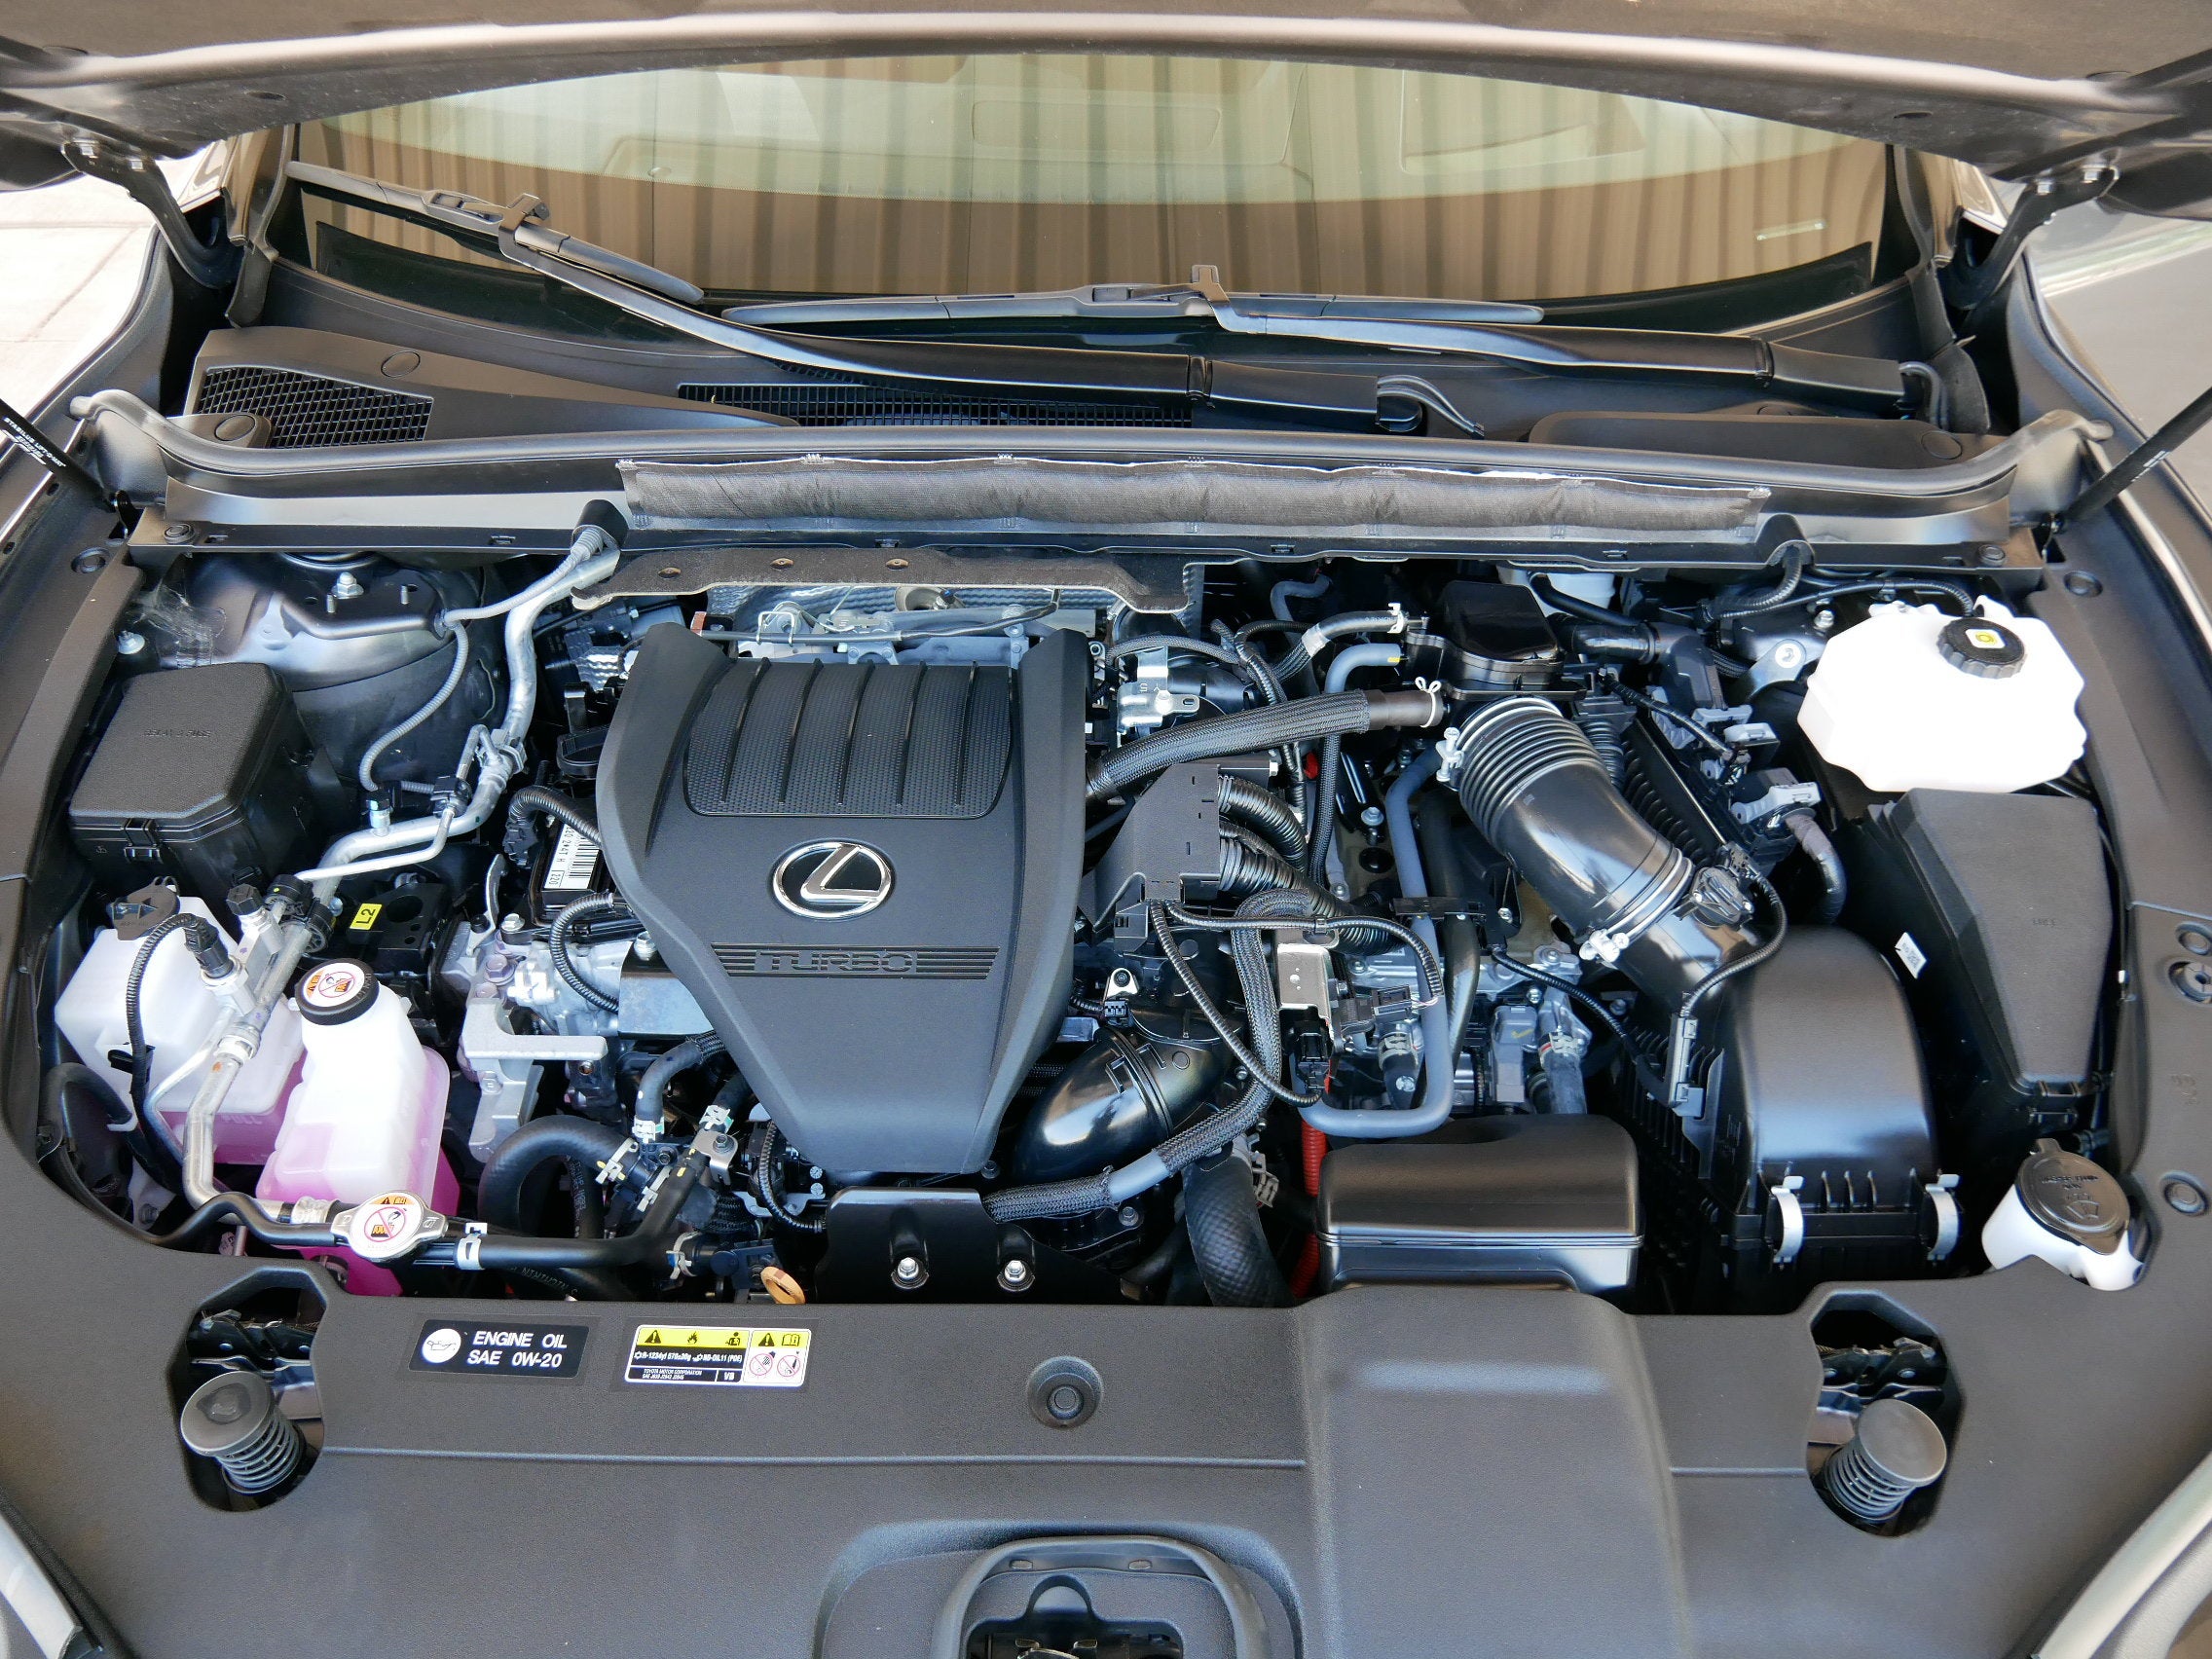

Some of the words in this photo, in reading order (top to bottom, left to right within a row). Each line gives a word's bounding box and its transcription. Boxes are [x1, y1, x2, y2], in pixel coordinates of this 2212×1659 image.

[355, 908, 377, 924] L2
[757, 950, 913, 972] TURBO
[472, 1330, 535, 1347] ENGINE
[541, 1333, 568, 1349] OIL
[466, 1348, 503, 1365] SAE
[511, 1351, 563, 1368] 0W-20
